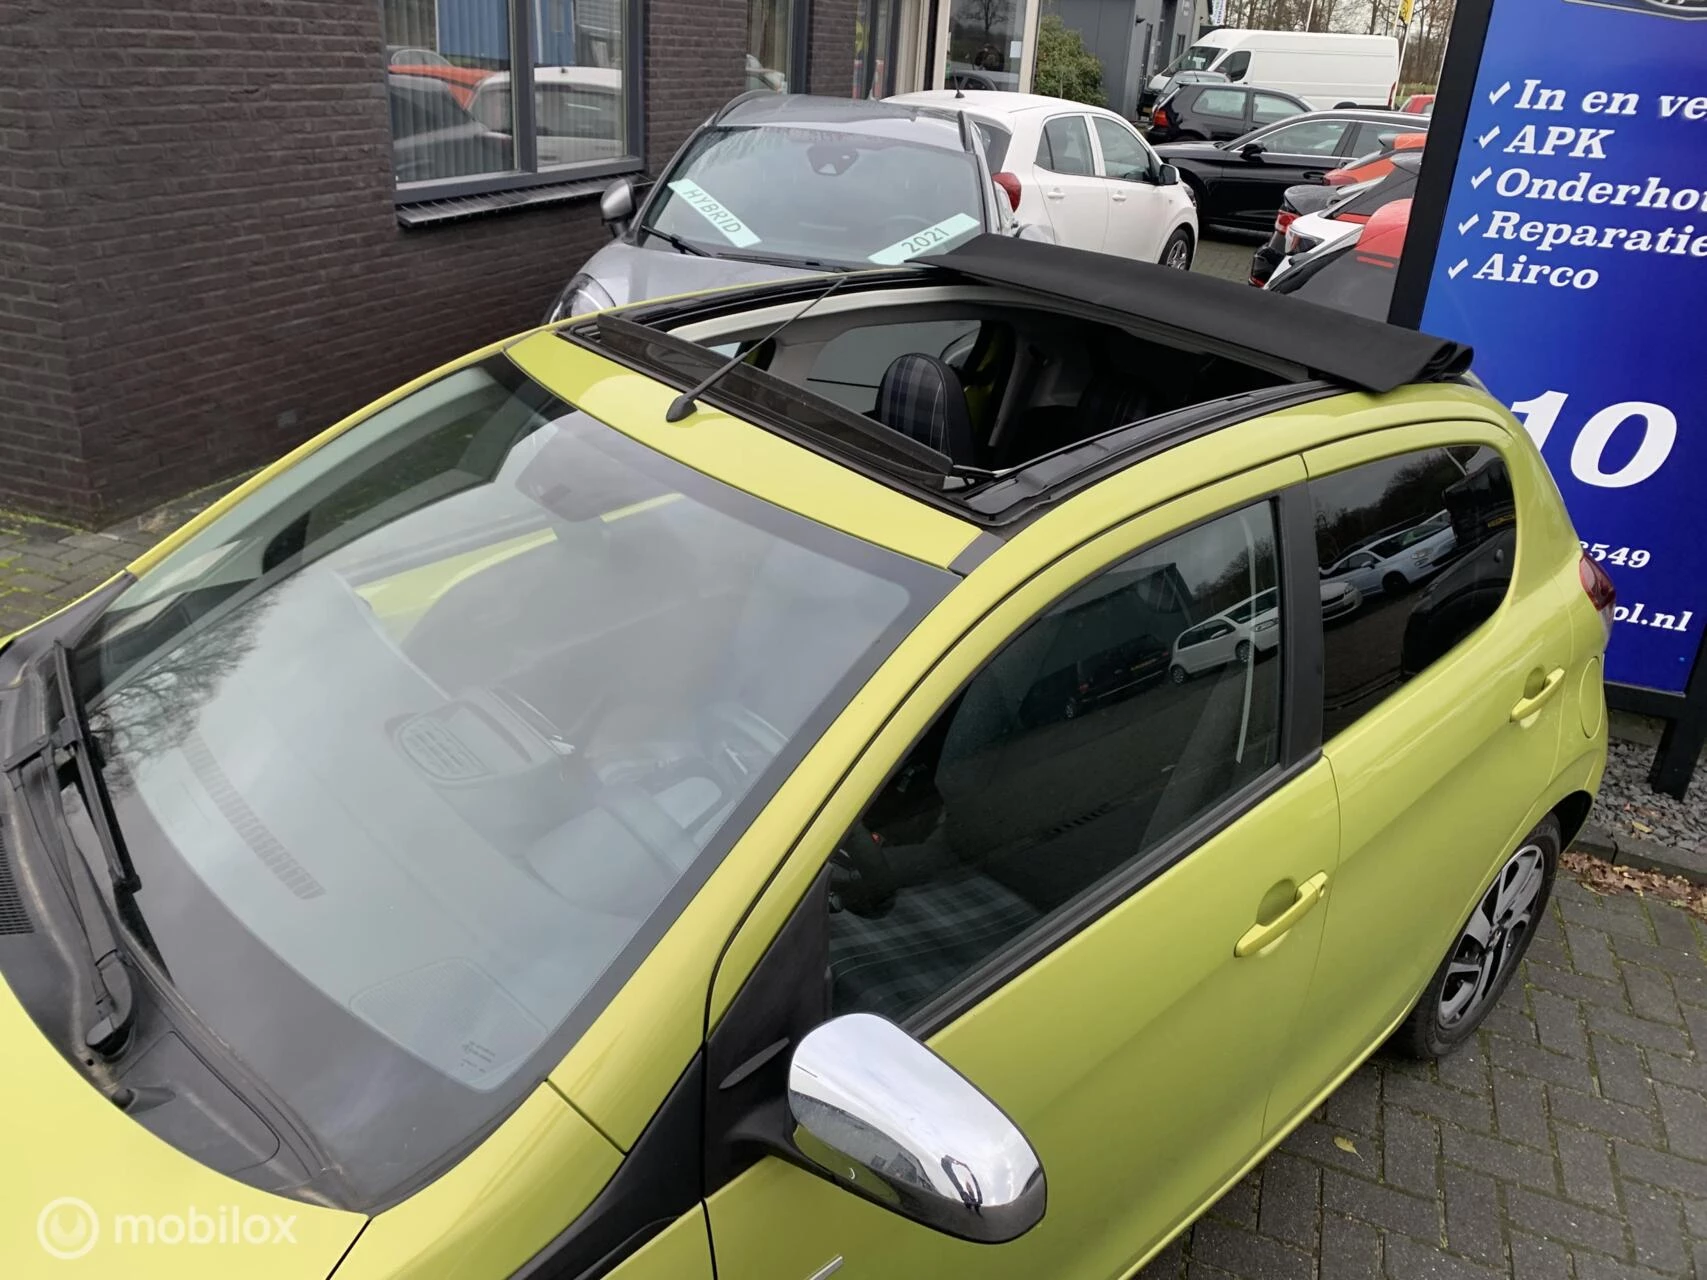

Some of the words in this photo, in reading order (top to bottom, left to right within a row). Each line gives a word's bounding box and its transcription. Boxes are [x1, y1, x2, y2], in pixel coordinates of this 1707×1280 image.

[1514, 79, 1566, 110] In
[1581, 90, 1640, 115] en
[1503, 124, 1615, 159] APK
[683, 189, 741, 232] HYBRID
[901, 227, 950, 253] 2021
[1472, 252, 1599, 290] Airco
